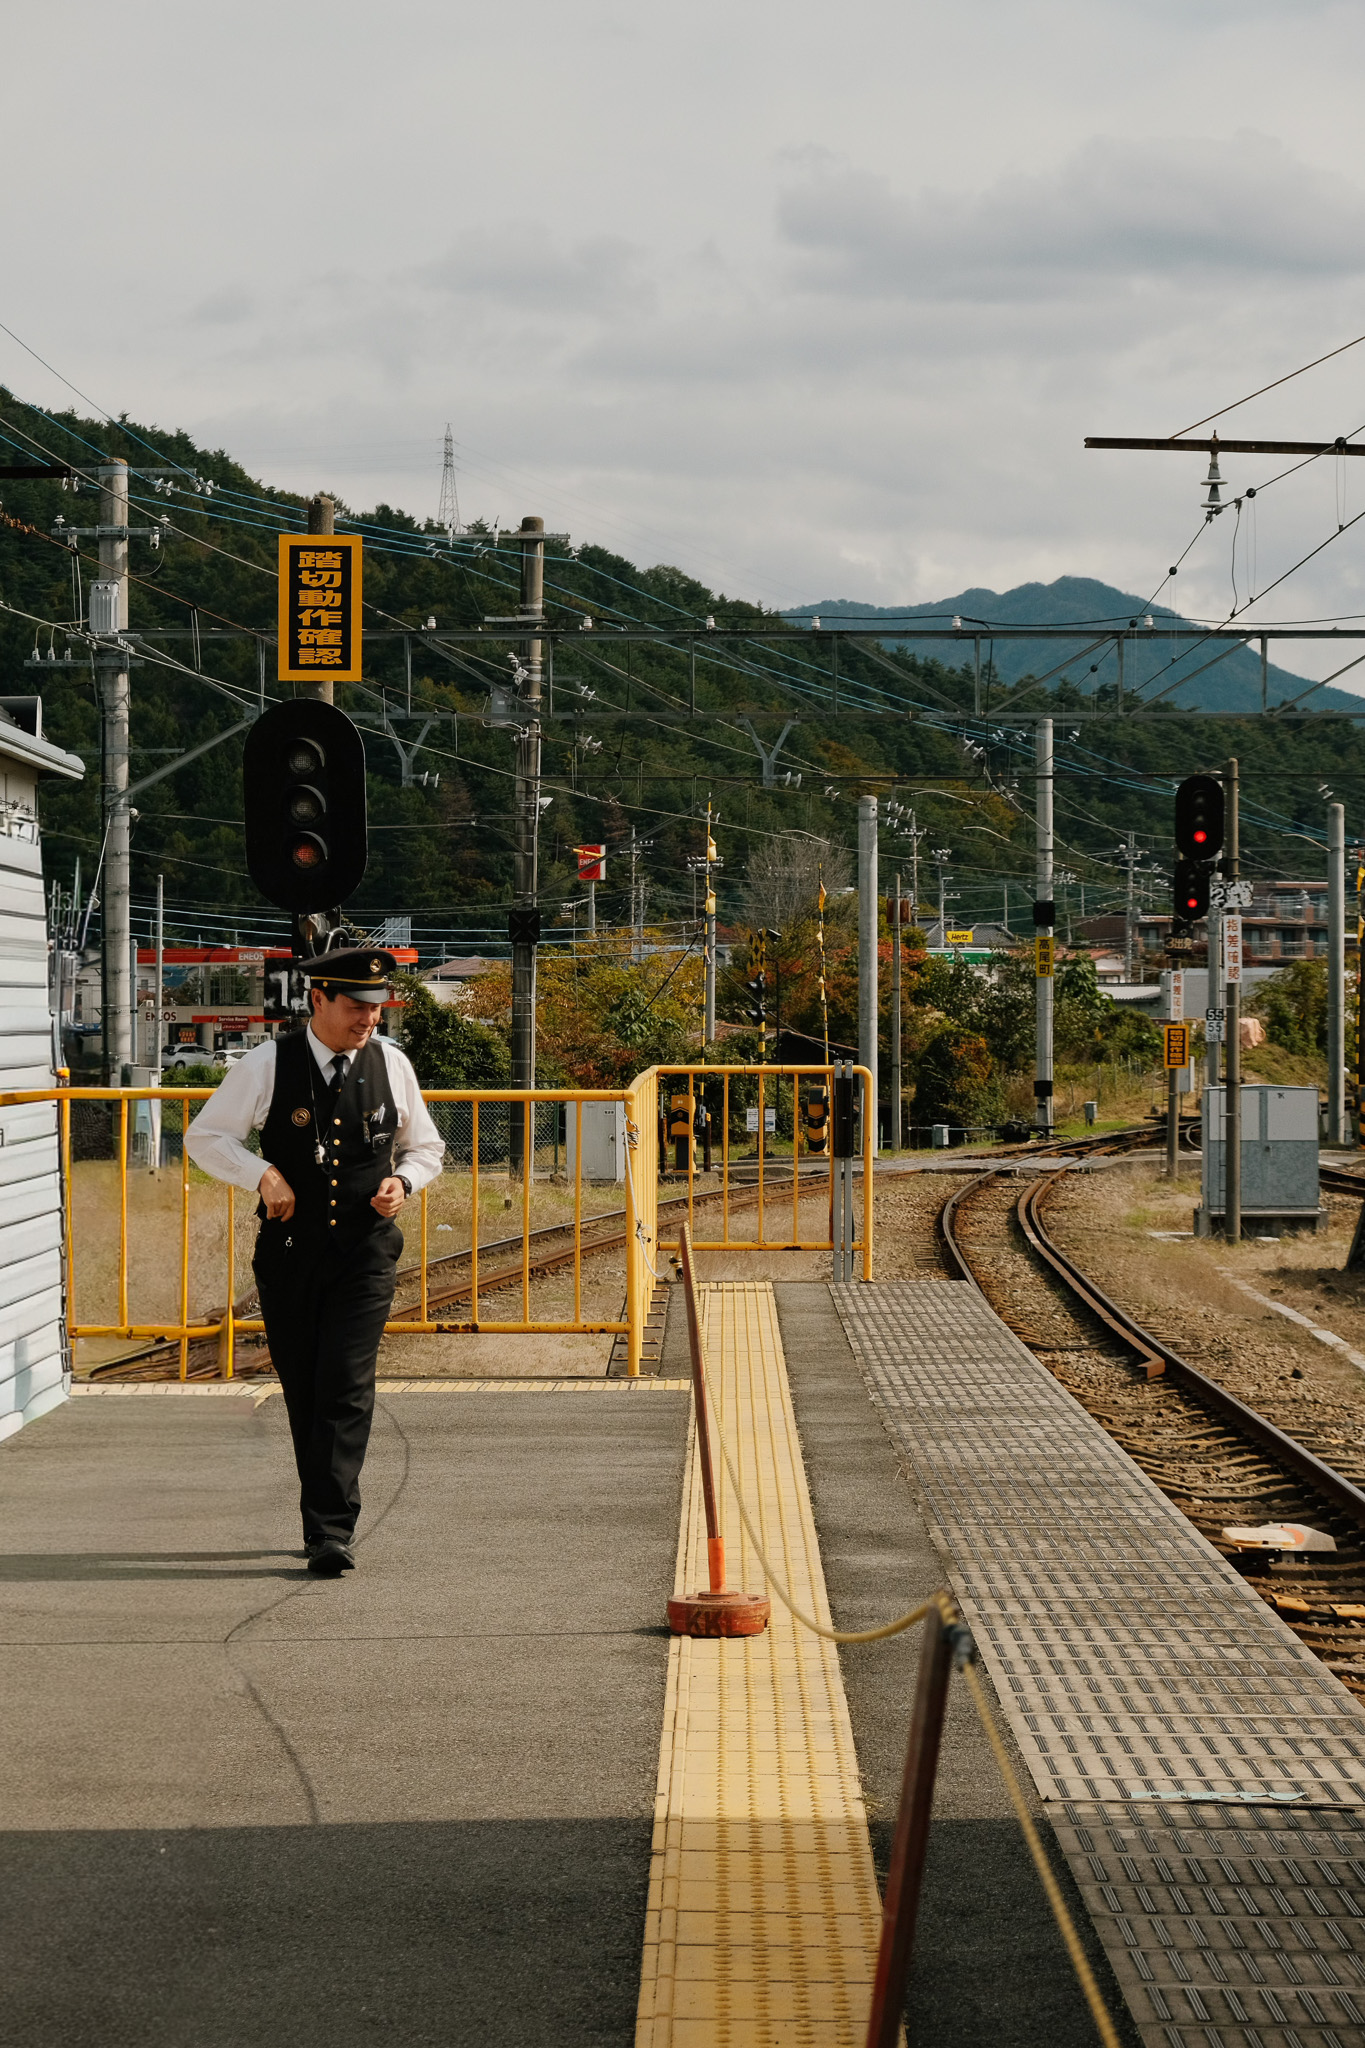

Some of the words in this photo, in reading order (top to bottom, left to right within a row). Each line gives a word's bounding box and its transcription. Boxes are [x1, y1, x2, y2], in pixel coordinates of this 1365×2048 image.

[297, 551, 343, 665] 踏切動作確認
[951, 933, 969, 941] Hertz
[238, 952, 264, 961] ENEOS
[1039, 939, 1050, 975] 高尾町
[145, 1011, 177, 1022] ENOS
[1207, 1009, 1223, 1020] 55
[1207, 1022, 1222, 1033] 55
